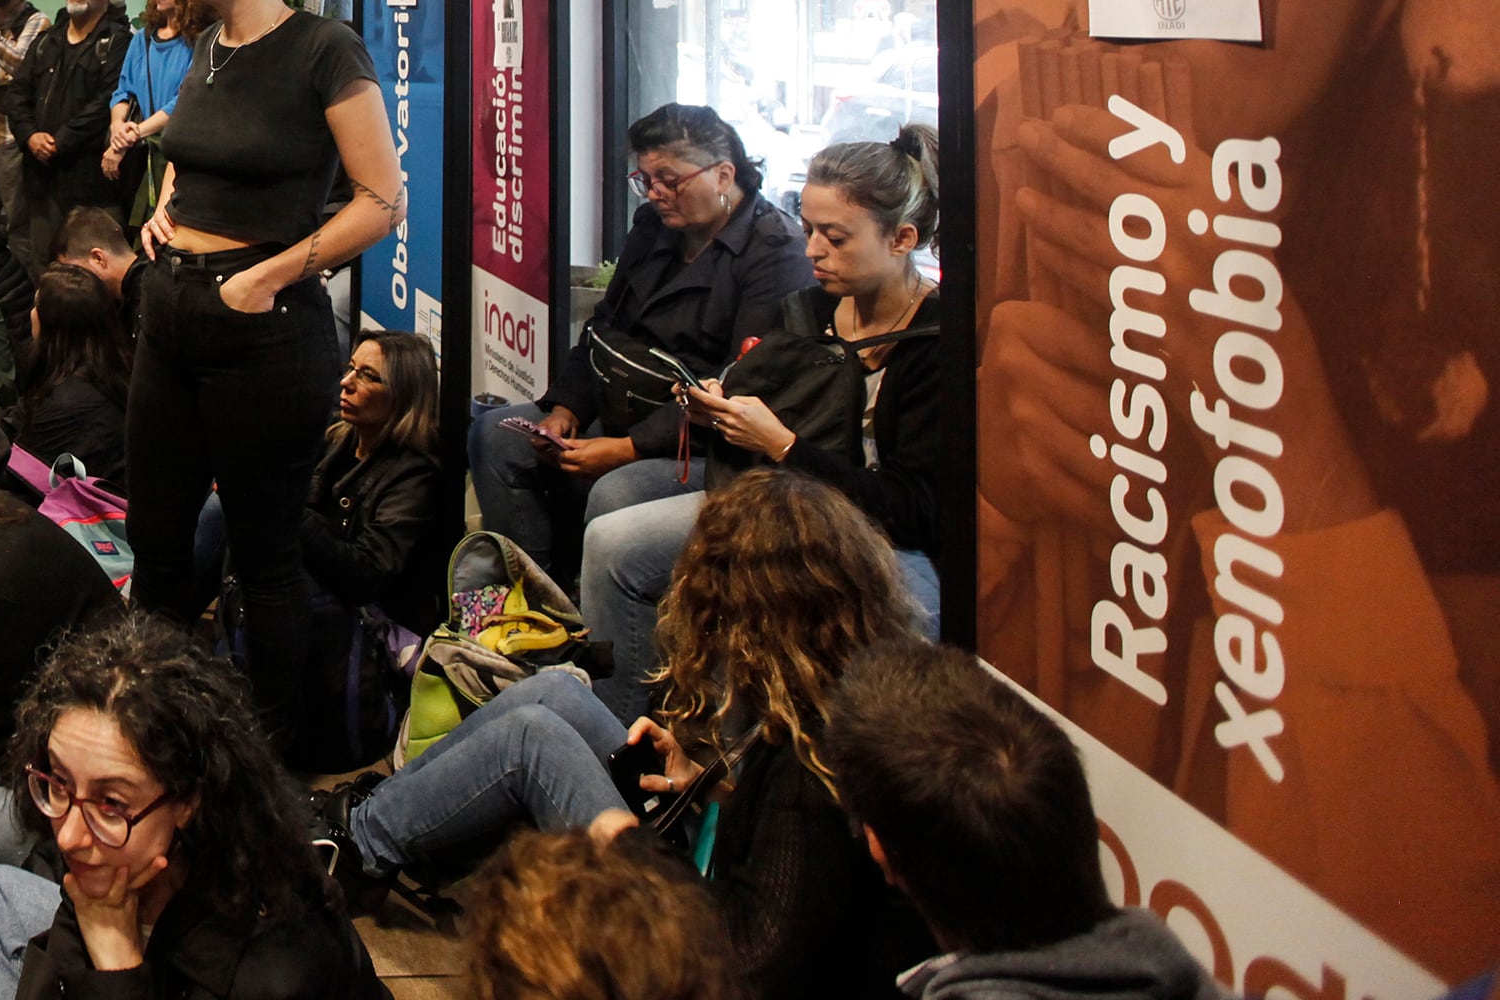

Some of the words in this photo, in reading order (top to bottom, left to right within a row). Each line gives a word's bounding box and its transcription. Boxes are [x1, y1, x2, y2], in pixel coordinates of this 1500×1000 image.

[392, 3, 409, 310] Obsrvatori
[493, 66, 506, 254] Educació
[508, 68, 523, 263] discrimin
[1107, 93, 1186, 161] y
[484, 289, 535, 364] inadi
[1090, 192, 1169, 706] Racismo
[1188, 136, 1284, 783] xenofobia
